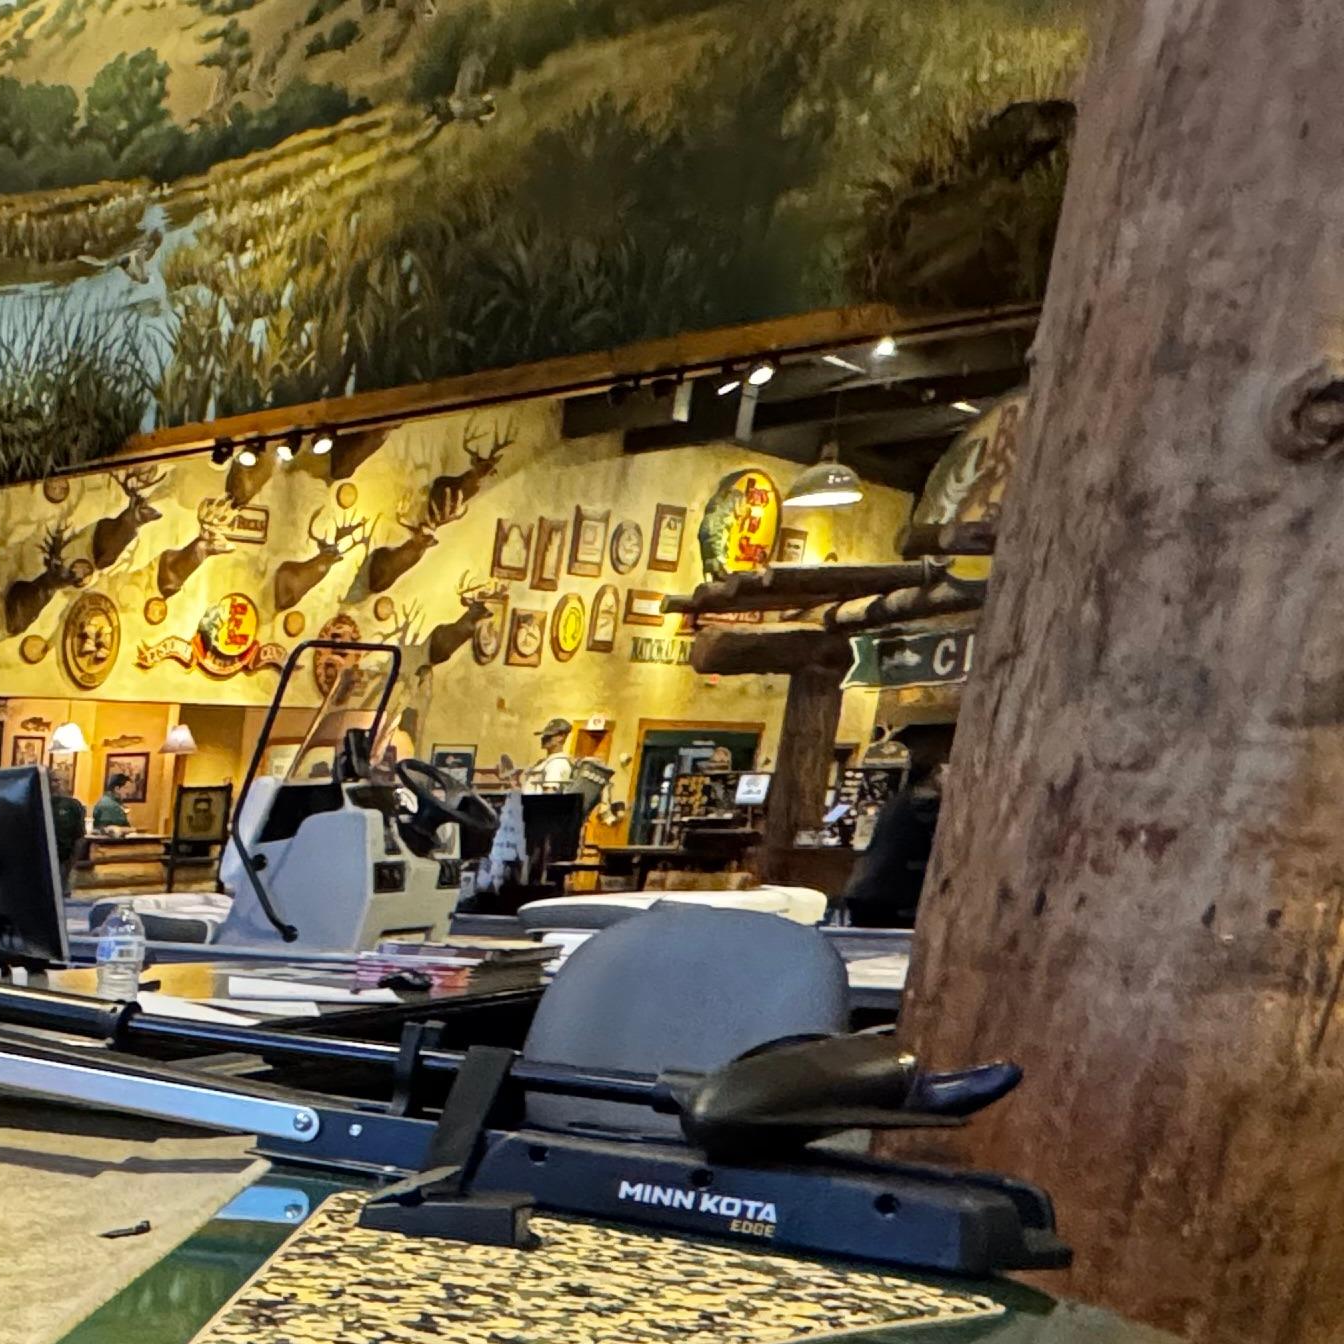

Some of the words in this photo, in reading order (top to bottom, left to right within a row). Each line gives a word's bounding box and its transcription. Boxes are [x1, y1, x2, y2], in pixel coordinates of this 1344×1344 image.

[618, 1181, 696, 1210] MINN
[699, 1193, 777, 1223] KOTA
[730, 1219, 776, 1238] EDGE
